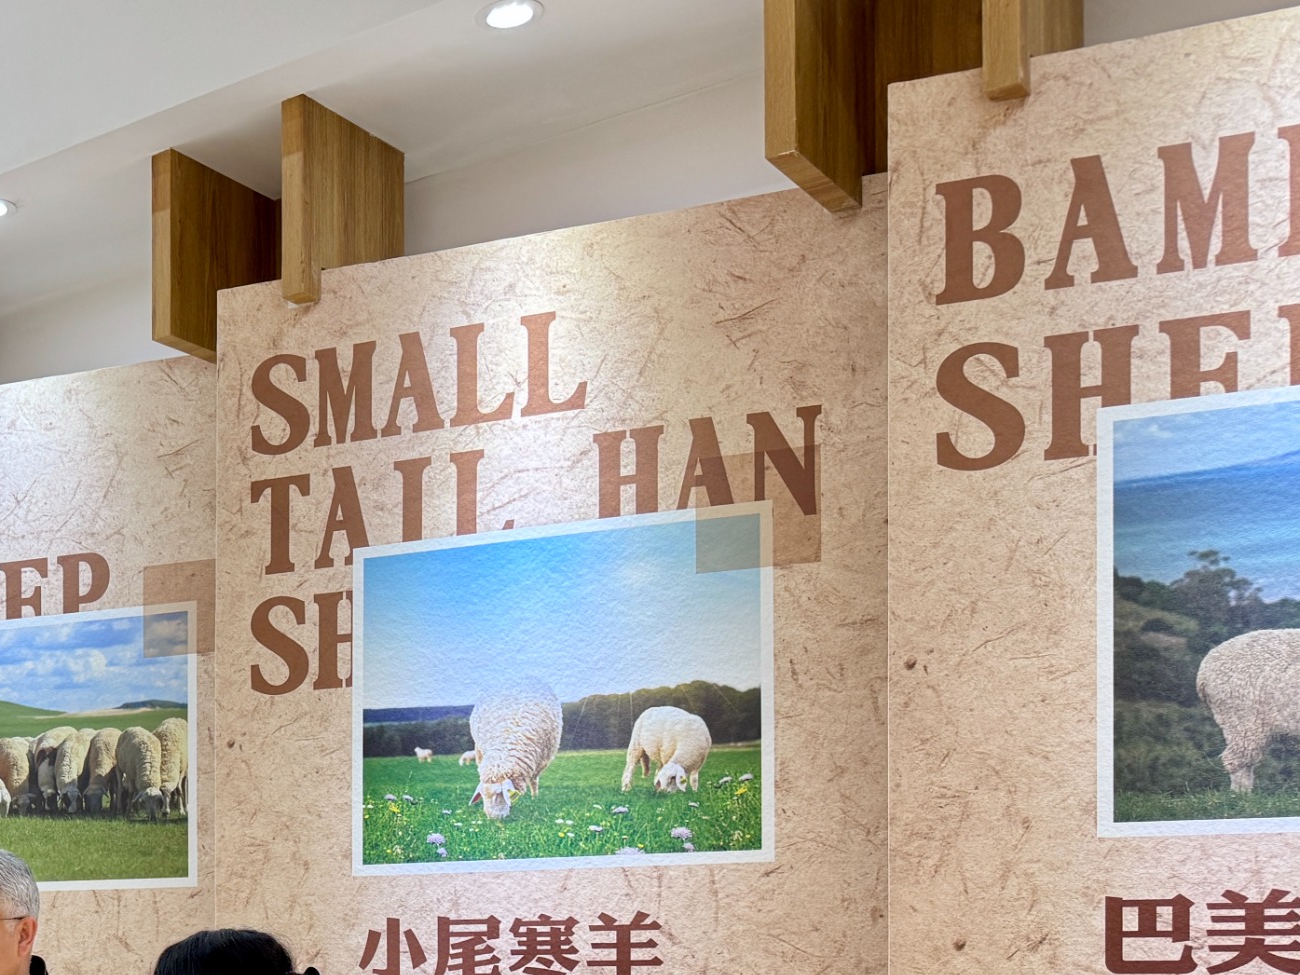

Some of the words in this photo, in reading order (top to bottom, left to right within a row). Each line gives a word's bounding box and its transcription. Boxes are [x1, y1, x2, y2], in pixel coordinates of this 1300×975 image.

[250, 311, 588, 456] SMALL
[935, 304, 1300, 472] SHE
[250, 448, 515, 576] TAIL
[592, 404, 823, 520] HAN
[1105, 889, 1300, 975] 巴美
